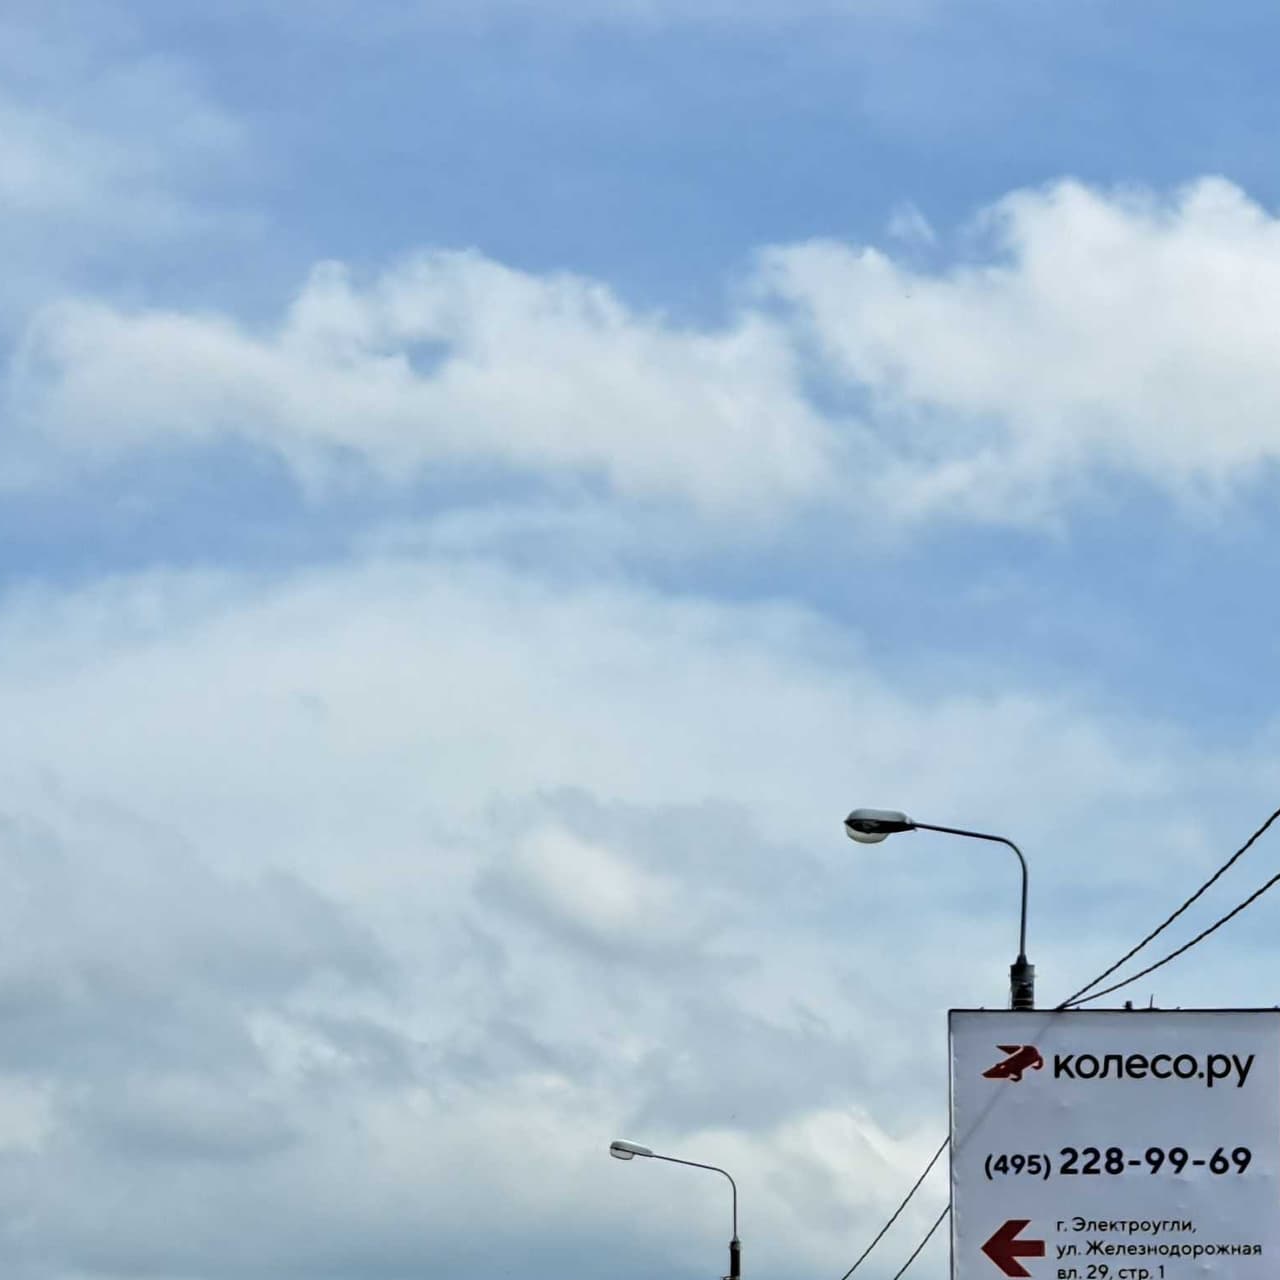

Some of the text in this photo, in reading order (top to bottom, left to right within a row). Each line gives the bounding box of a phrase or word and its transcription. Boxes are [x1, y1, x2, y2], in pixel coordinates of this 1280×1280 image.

[1053, 1053, 1256, 1088] колесо.ру
[984, 1146, 1253, 1181] (495) 228-99-69
[1056, 1216, 1197, 1236] г. Электроугли,
[1056, 1239, 1263, 1260] ул. Железнодорожная
[1057, 1267, 1083, 1280] вл.
[1158, 1264, 1166, 1280] 1
